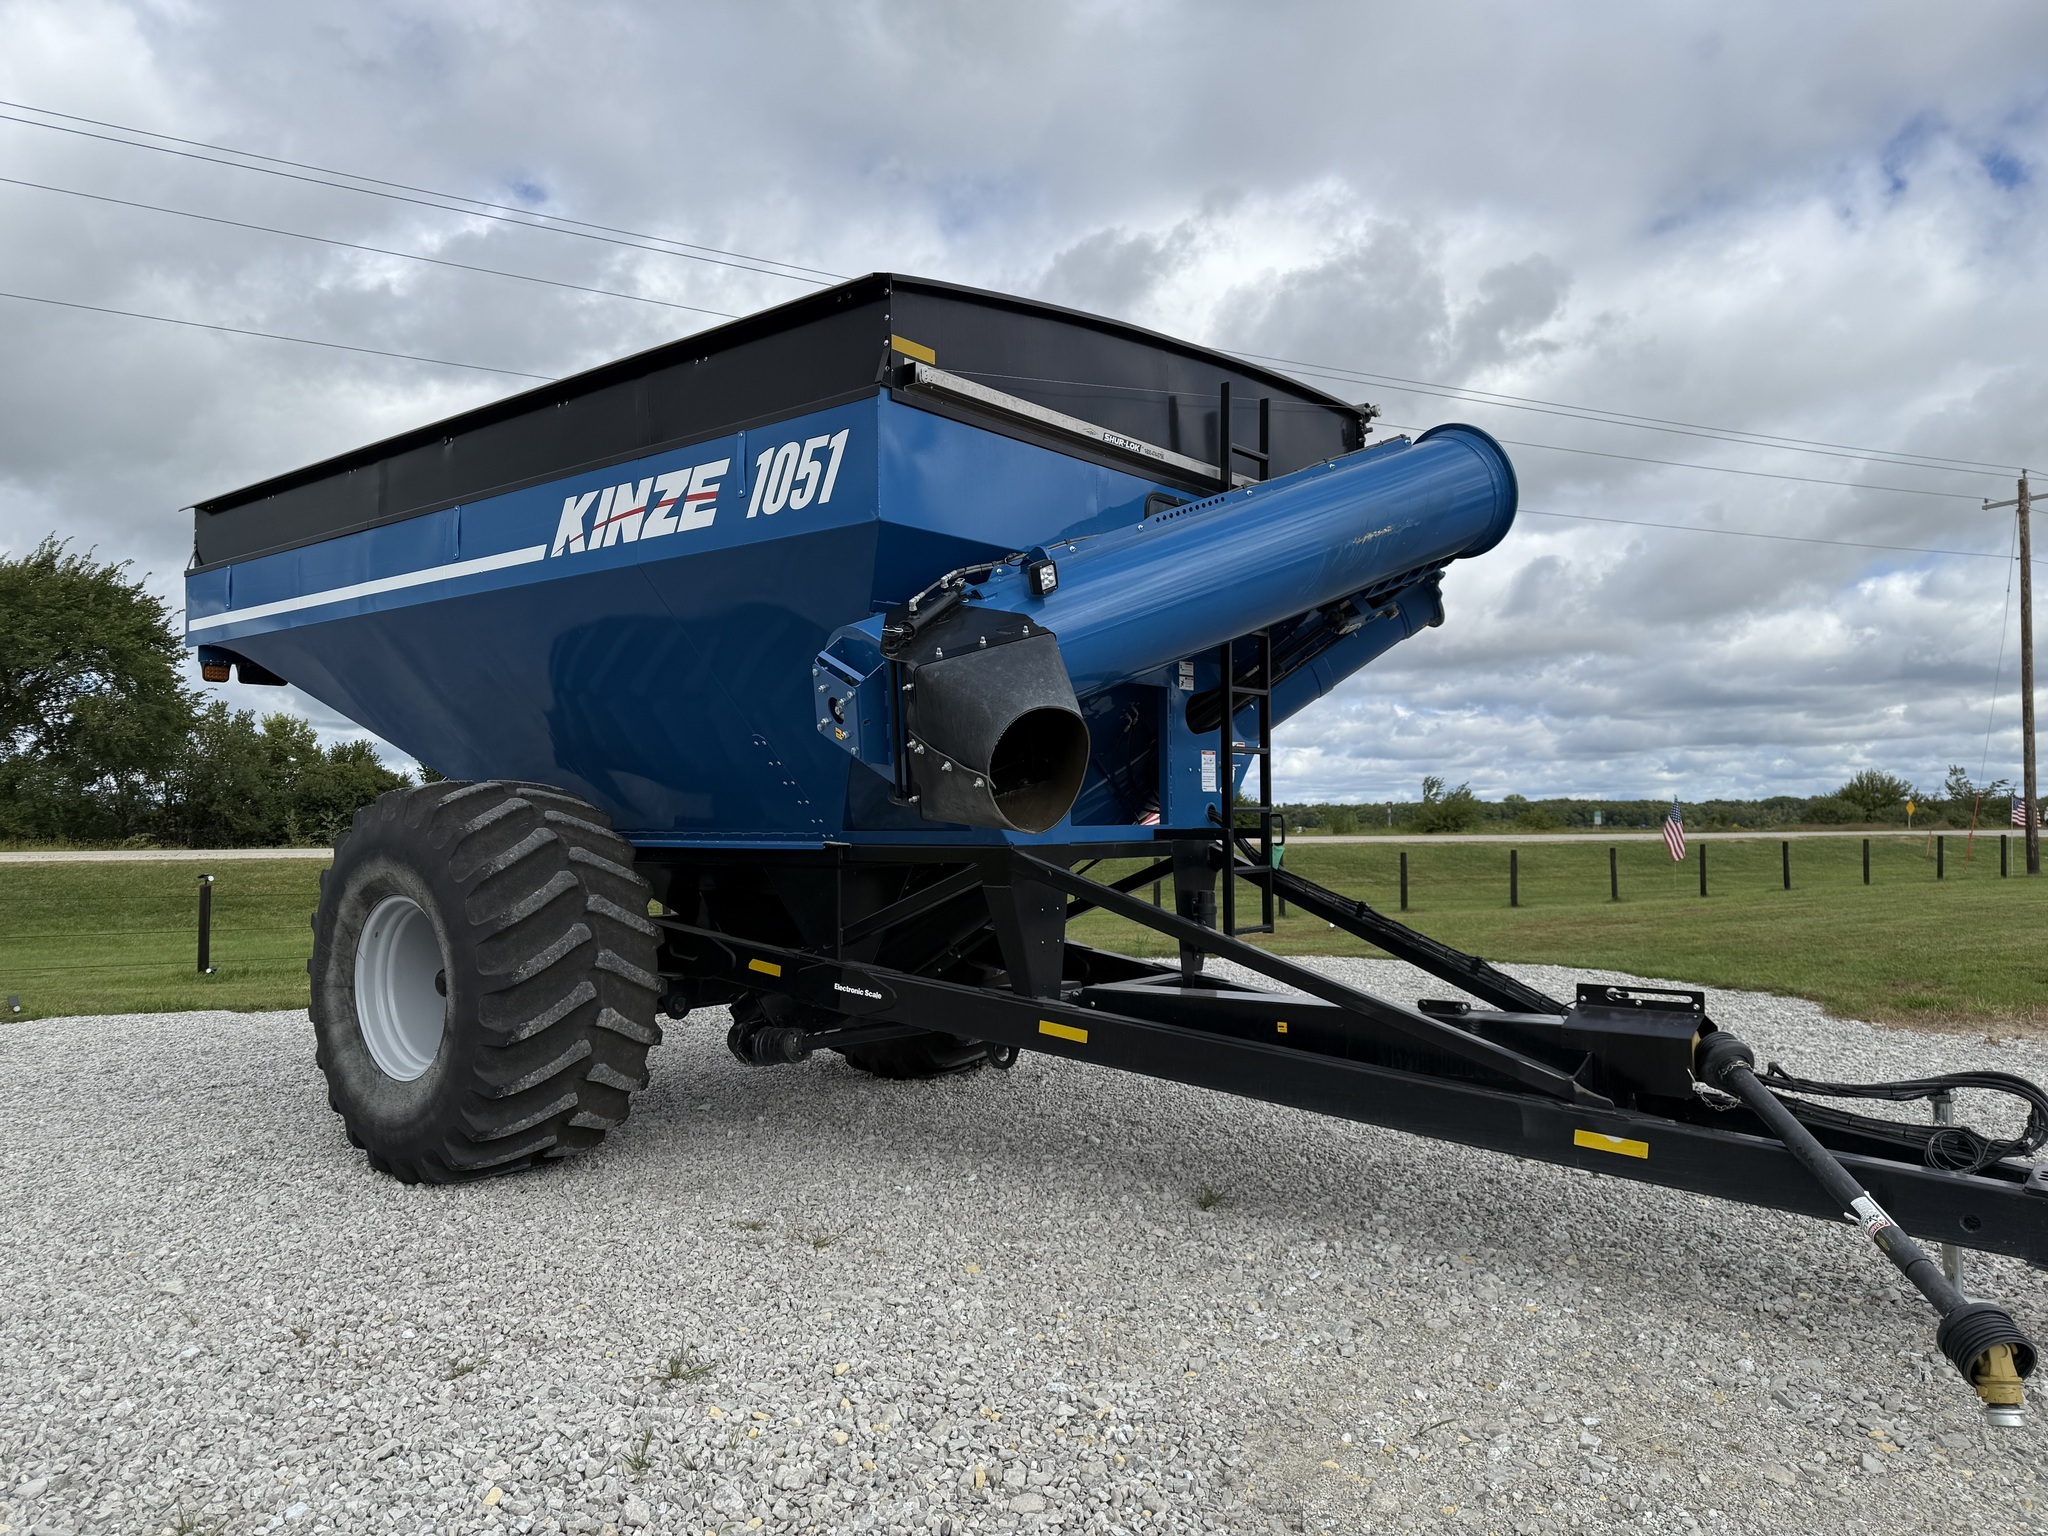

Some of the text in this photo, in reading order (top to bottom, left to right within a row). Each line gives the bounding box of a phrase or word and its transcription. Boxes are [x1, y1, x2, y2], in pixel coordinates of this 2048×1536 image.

[551, 429, 849, 557] KINZE 1051
[834, 983, 882, 999] Electronic Scale
